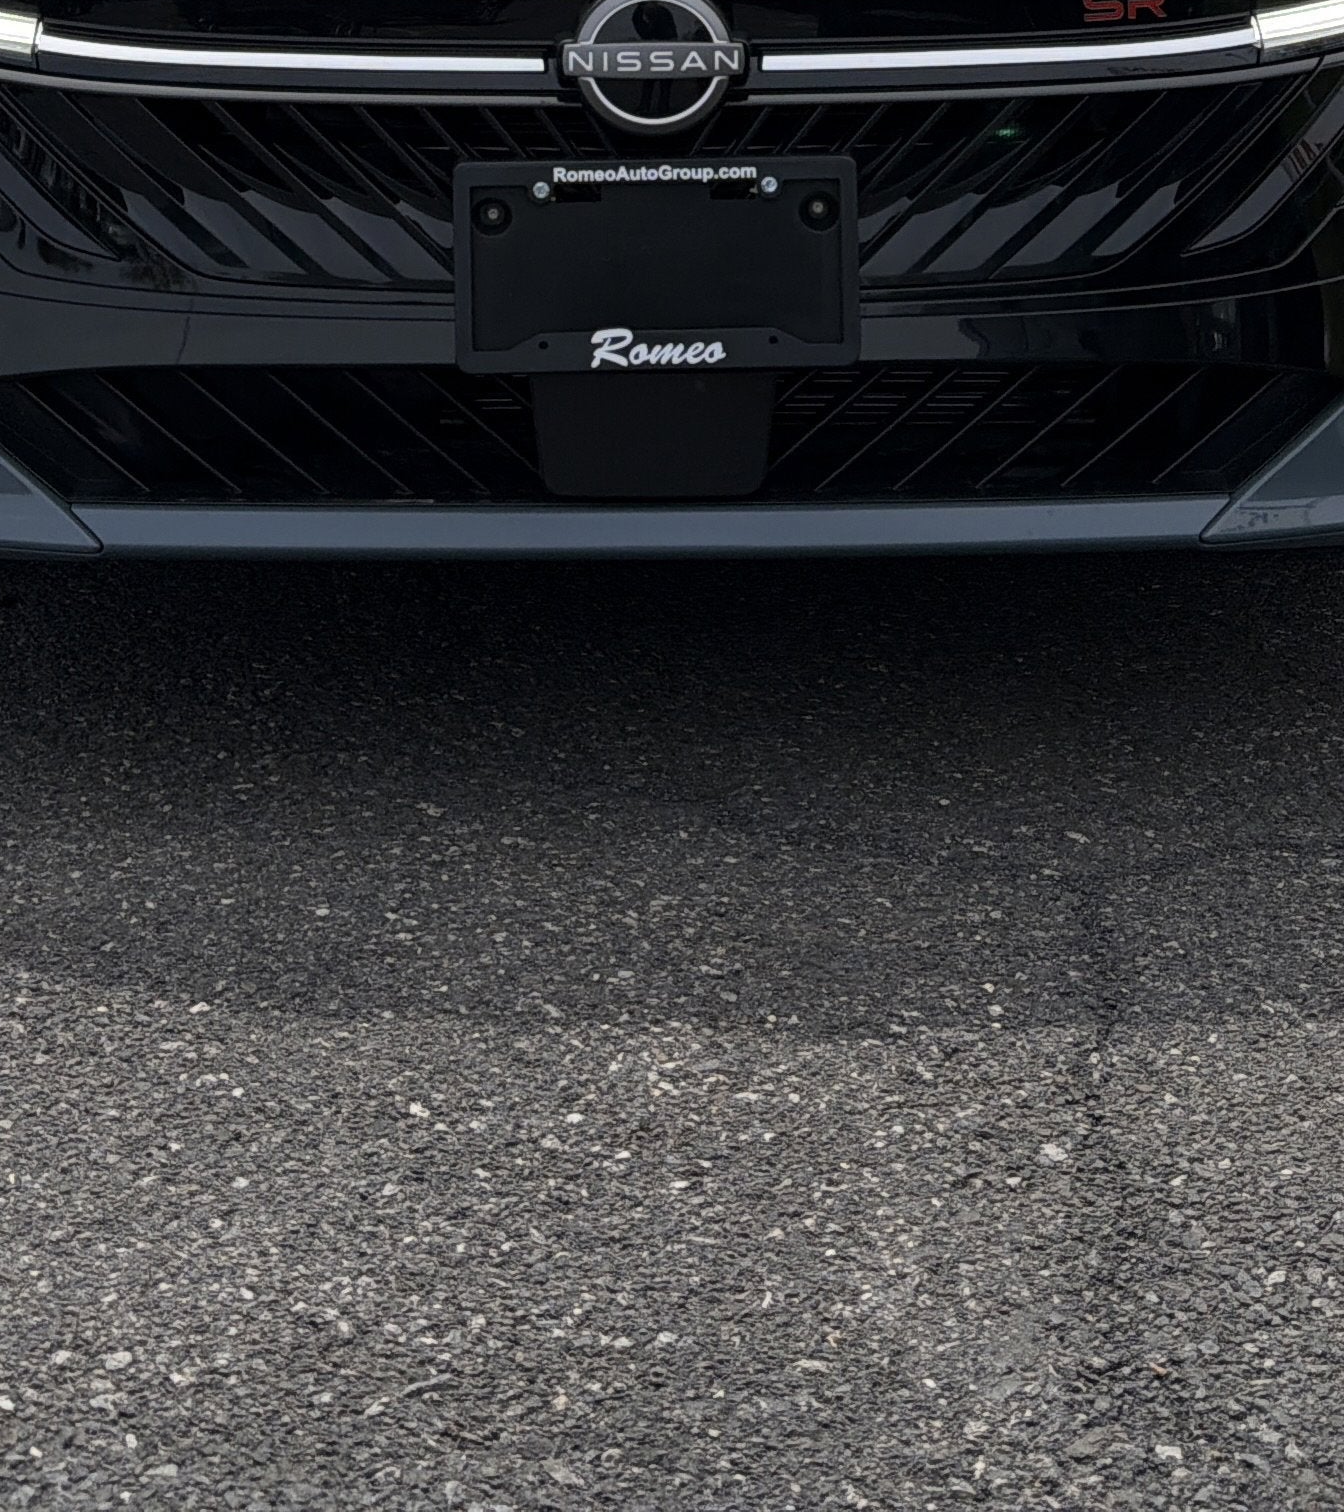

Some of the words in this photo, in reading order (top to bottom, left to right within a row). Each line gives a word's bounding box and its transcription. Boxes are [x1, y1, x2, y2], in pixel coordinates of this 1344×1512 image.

[568, 49, 739, 72] NISSAN
[552, 164, 757, 183] RomeoAutoGroup.com
[590, 328, 727, 369] Romeo
